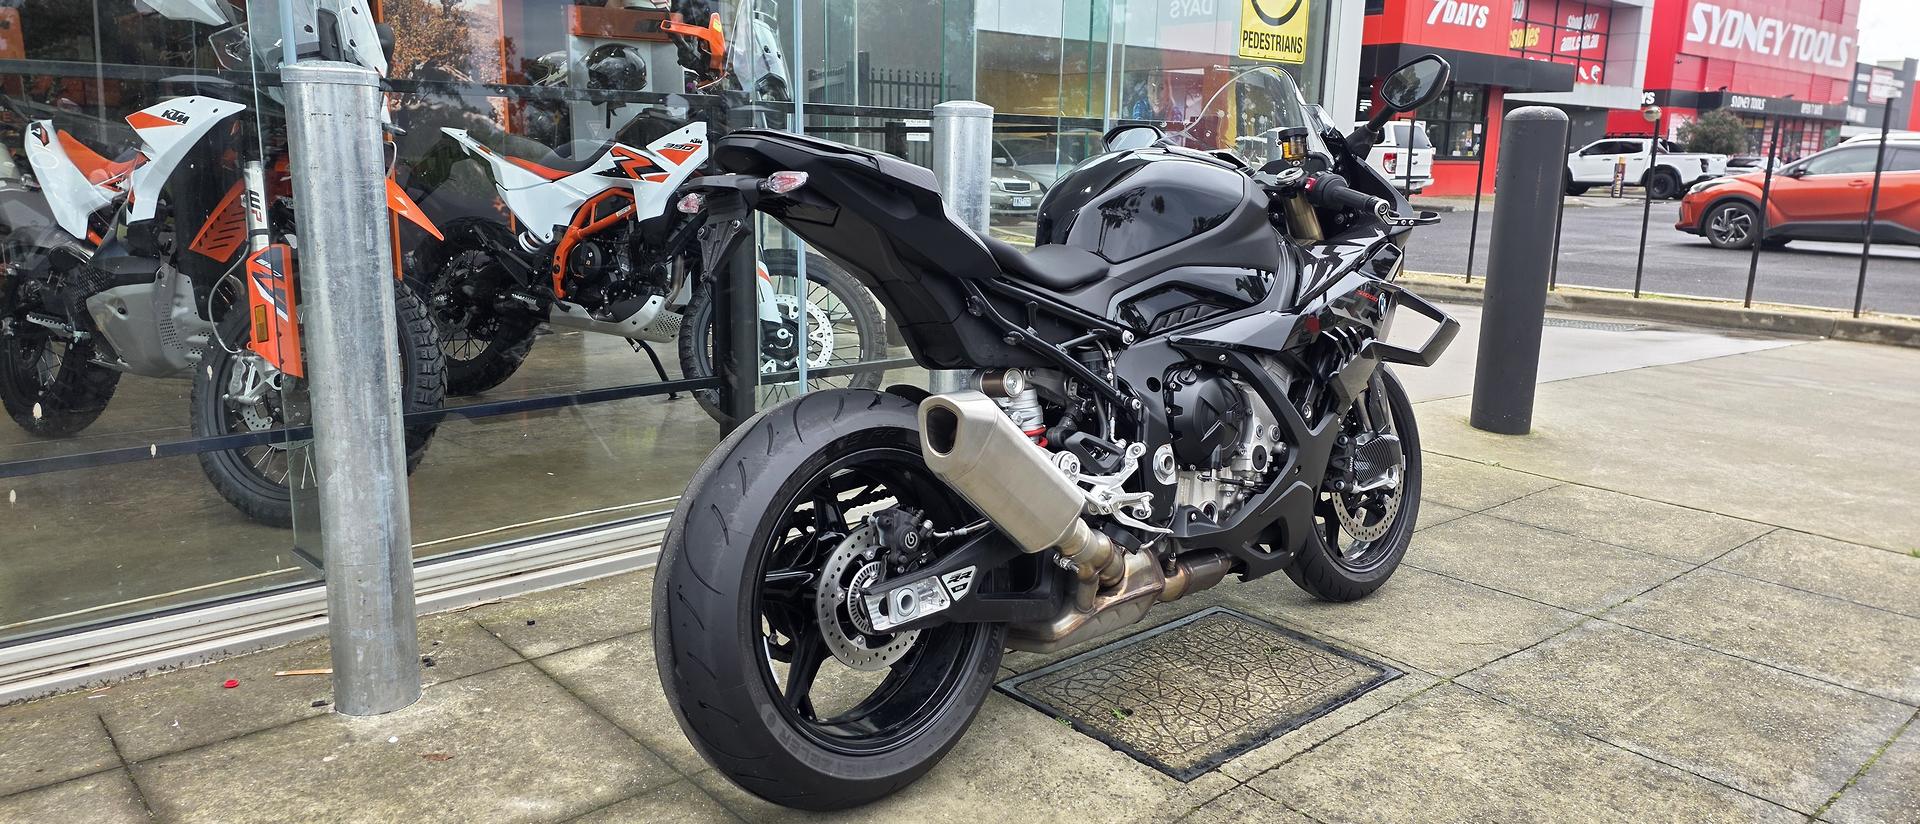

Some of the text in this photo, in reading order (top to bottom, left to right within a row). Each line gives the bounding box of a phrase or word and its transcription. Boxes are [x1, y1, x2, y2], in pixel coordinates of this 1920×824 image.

[1242, 30, 1303, 54] PEDESTRIANS
[1686, 2, 1853, 68] SYDNEY TOOLS
[1750, 97, 1767, 111] TOOLS
[161, 108, 190, 125] KTM
